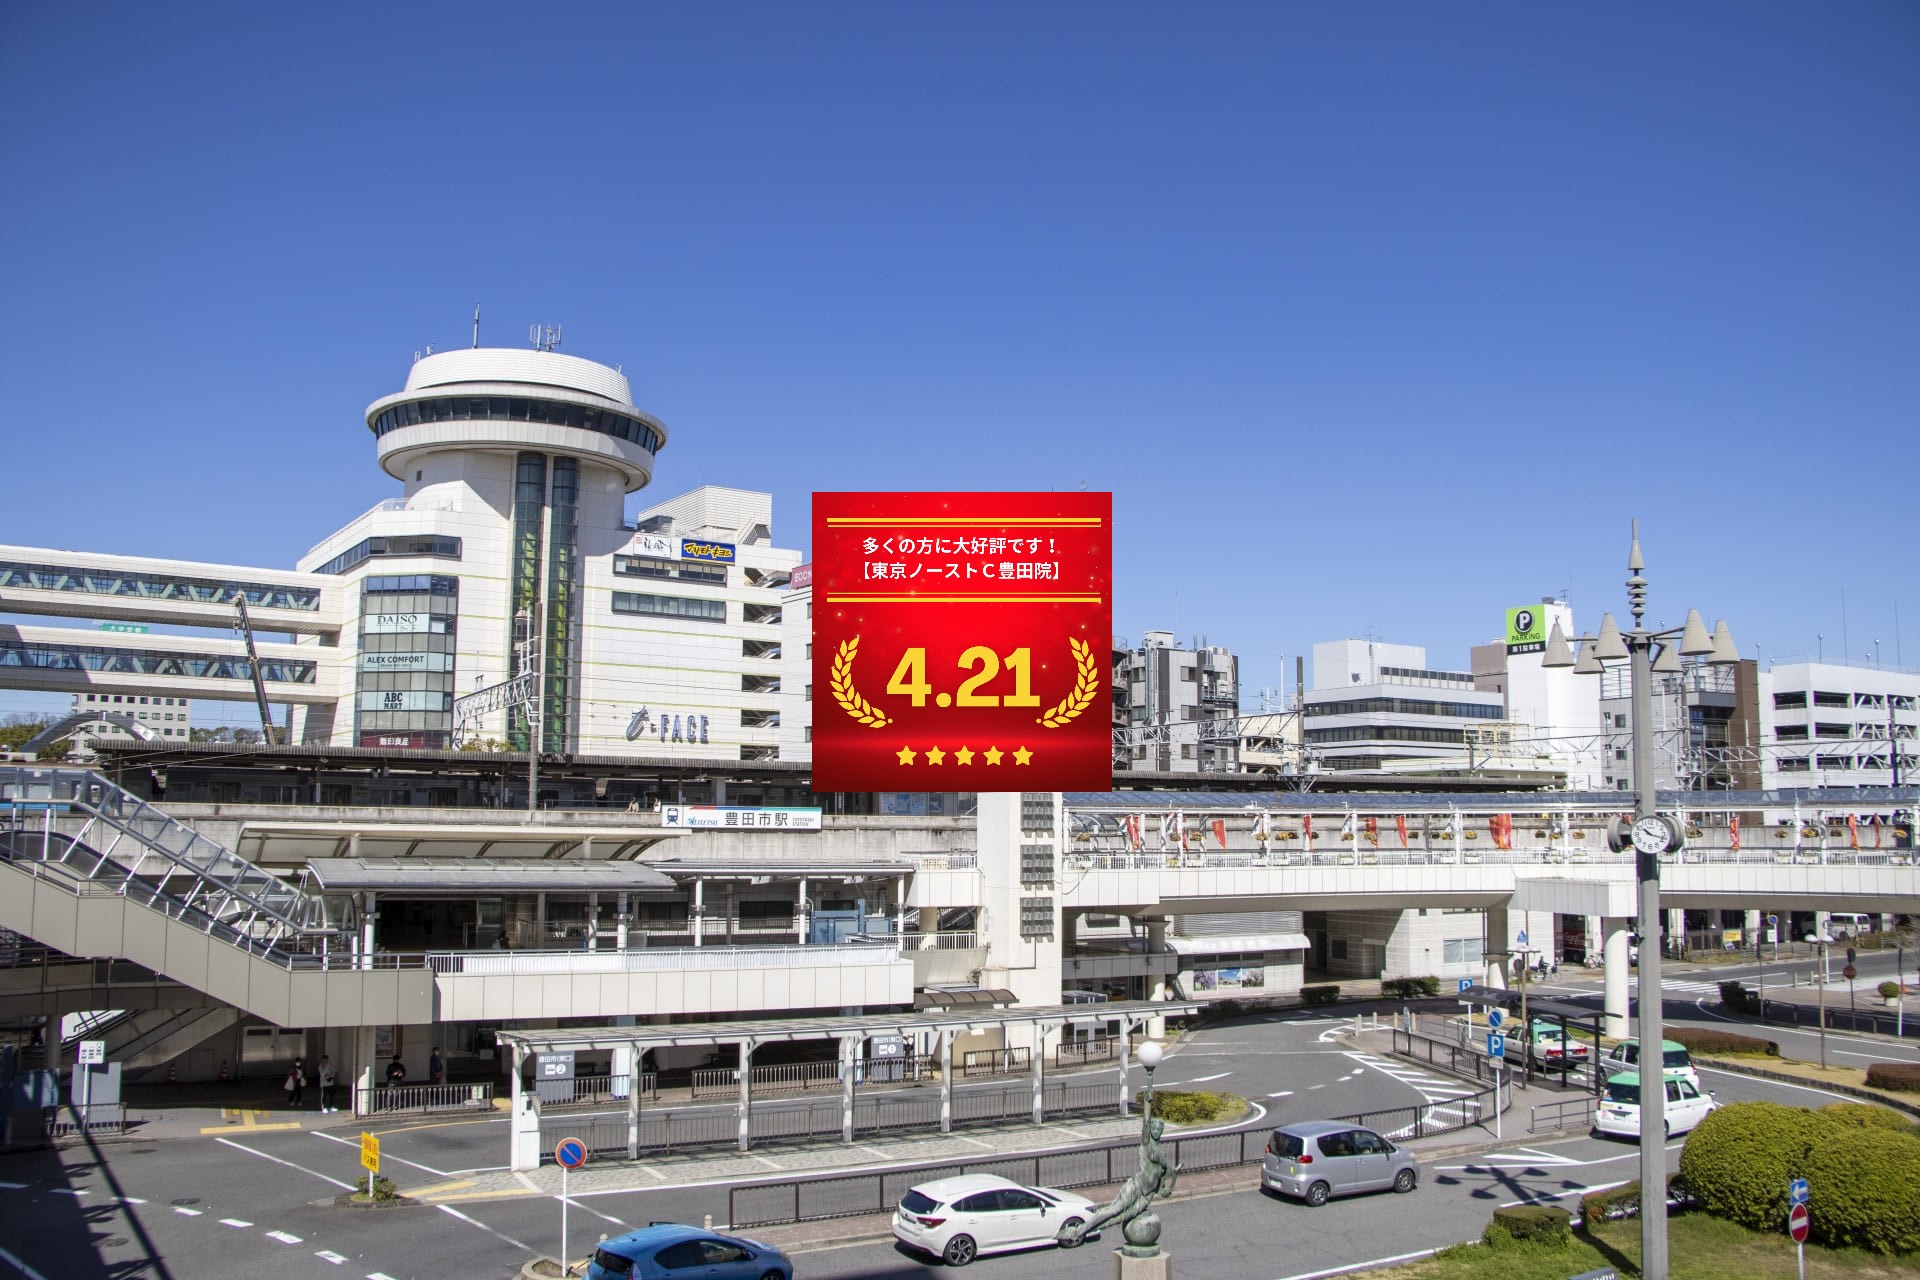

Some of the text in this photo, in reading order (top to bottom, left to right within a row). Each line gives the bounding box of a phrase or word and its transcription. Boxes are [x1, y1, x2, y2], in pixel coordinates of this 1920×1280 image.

[377, 614, 417, 625] DAISO
[1511, 633, 1541, 642] PARKING
[366, 655, 425, 664] ALEX COMFORT
[384, 692, 403, 702] ABC
[383, 702, 403, 710] MART
[724, 811, 789, 827] 豊田市駅
[1491, 1036, 1501, 1054] P
